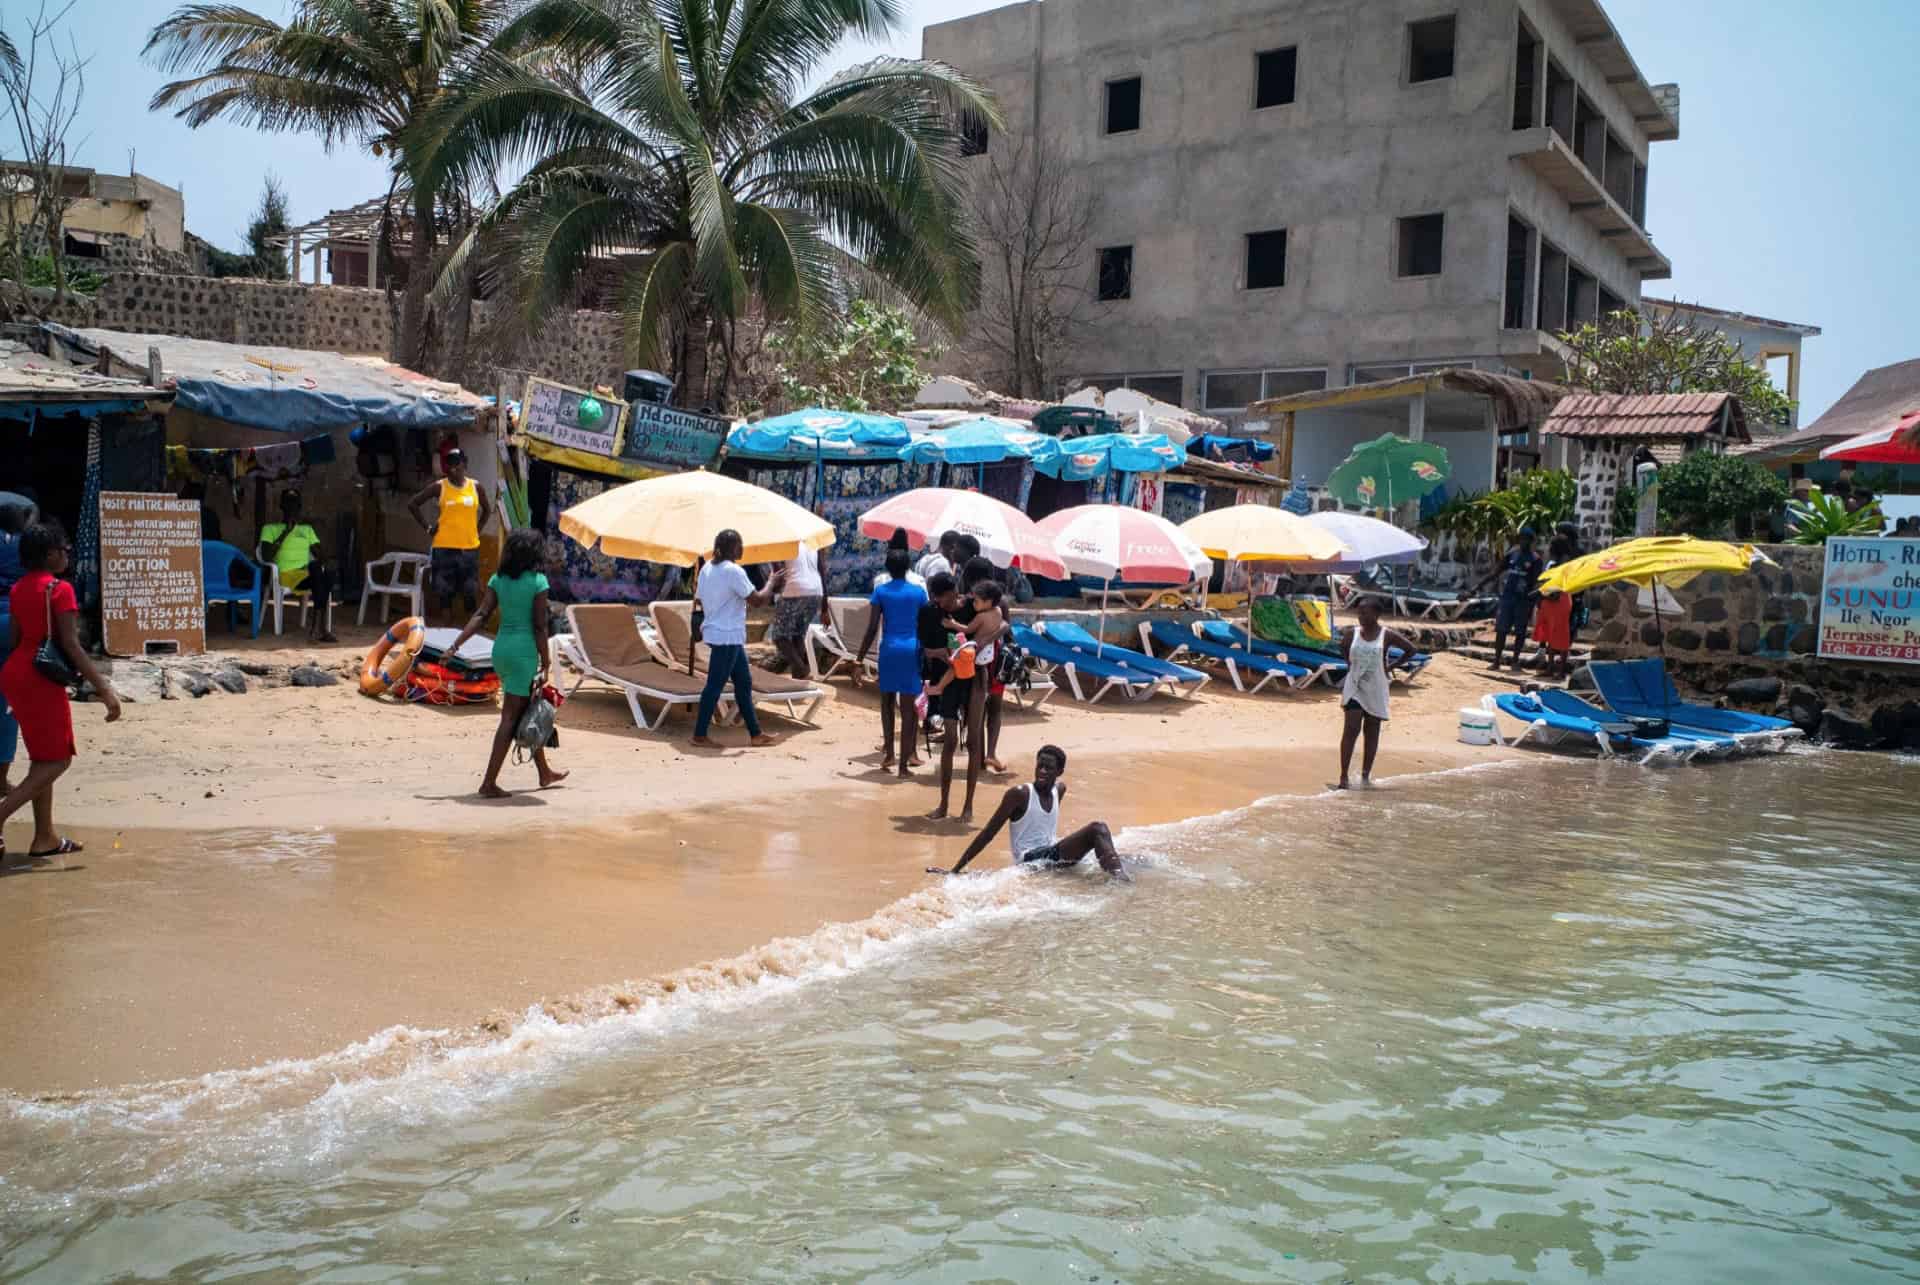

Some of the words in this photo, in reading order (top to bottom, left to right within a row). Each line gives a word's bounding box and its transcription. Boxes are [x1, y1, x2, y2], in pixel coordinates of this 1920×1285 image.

[1826, 588, 1912, 610] SUNU
[1870, 610, 1912, 631] Ngor
[1824, 626, 1889, 643] Terrasse
[1855, 644, 1873, 656] 77
[1875, 645, 1900, 657] 647
